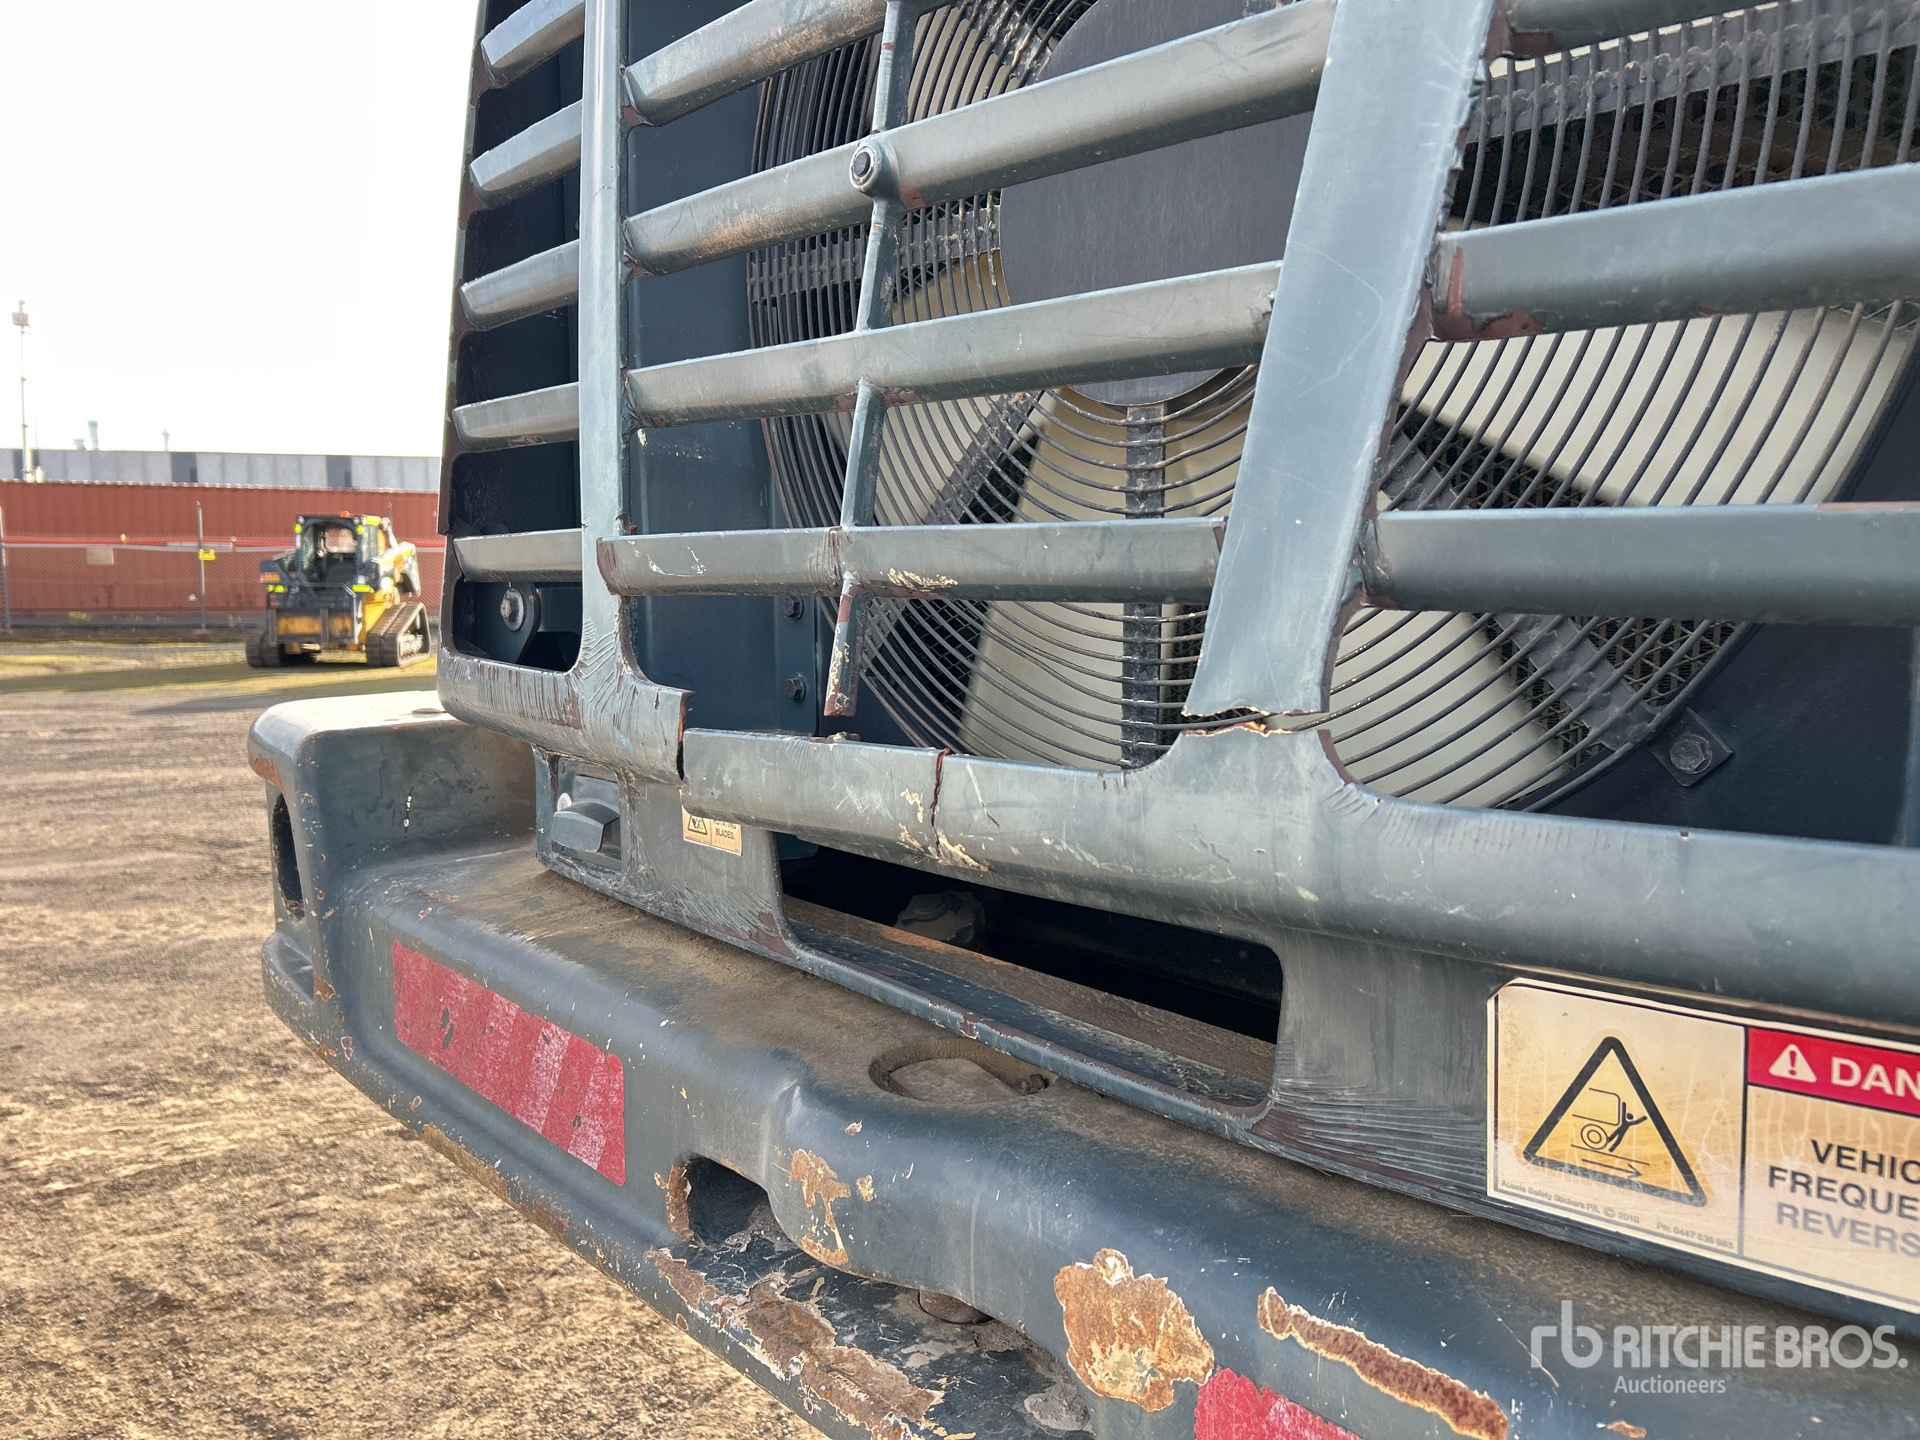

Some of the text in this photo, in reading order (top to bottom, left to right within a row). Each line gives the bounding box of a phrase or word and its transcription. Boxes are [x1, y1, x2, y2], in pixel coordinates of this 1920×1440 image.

[1830, 1056, 1920, 1100] DAN
[1811, 1138, 1920, 1185] VEHIC
[1501, 1180, 1526, 1193] Aussie
[1528, 1186, 1552, 1201] Safety
[1554, 1194, 1585, 1209] Stickers
[1586, 1202, 1600, 1214] P/L
[1768, 1165, 1920, 1222] FREQUE
[1776, 1201, 1920, 1258] REVERS
